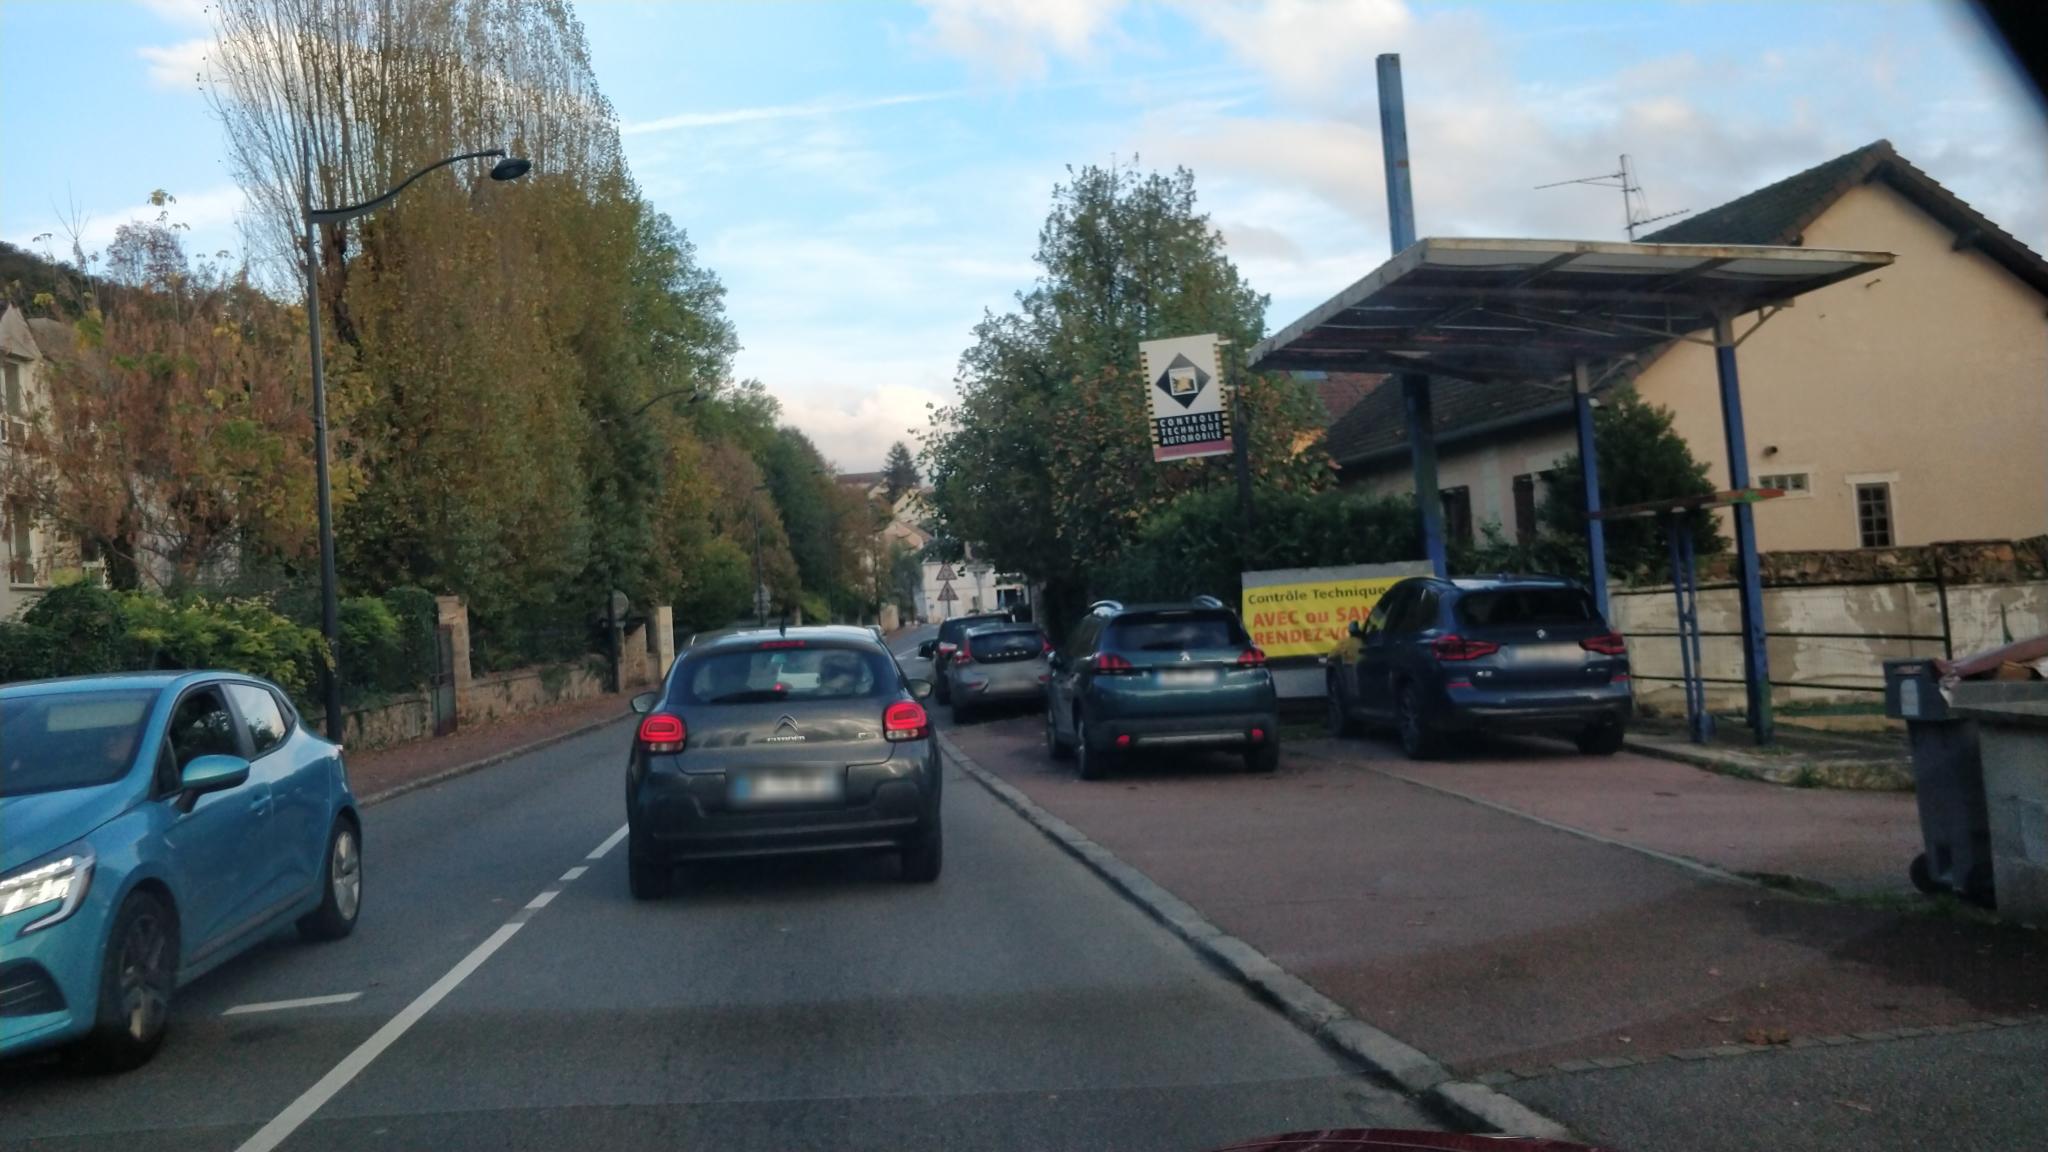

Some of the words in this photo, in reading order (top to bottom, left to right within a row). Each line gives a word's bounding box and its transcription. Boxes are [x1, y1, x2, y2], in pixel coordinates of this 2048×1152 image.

[1160, 413, 1220, 427] CONTROLE
[1161, 422, 1221, 436] TECHNIQUE
[1162, 431, 1222, 445] AUTOMOBILE
[1248, 588, 1307, 605] Contrôle
[1313, 585, 1387, 600] Technique
[1253, 611, 1299, 628] AVEC
[1305, 611, 1329, 624] ou
